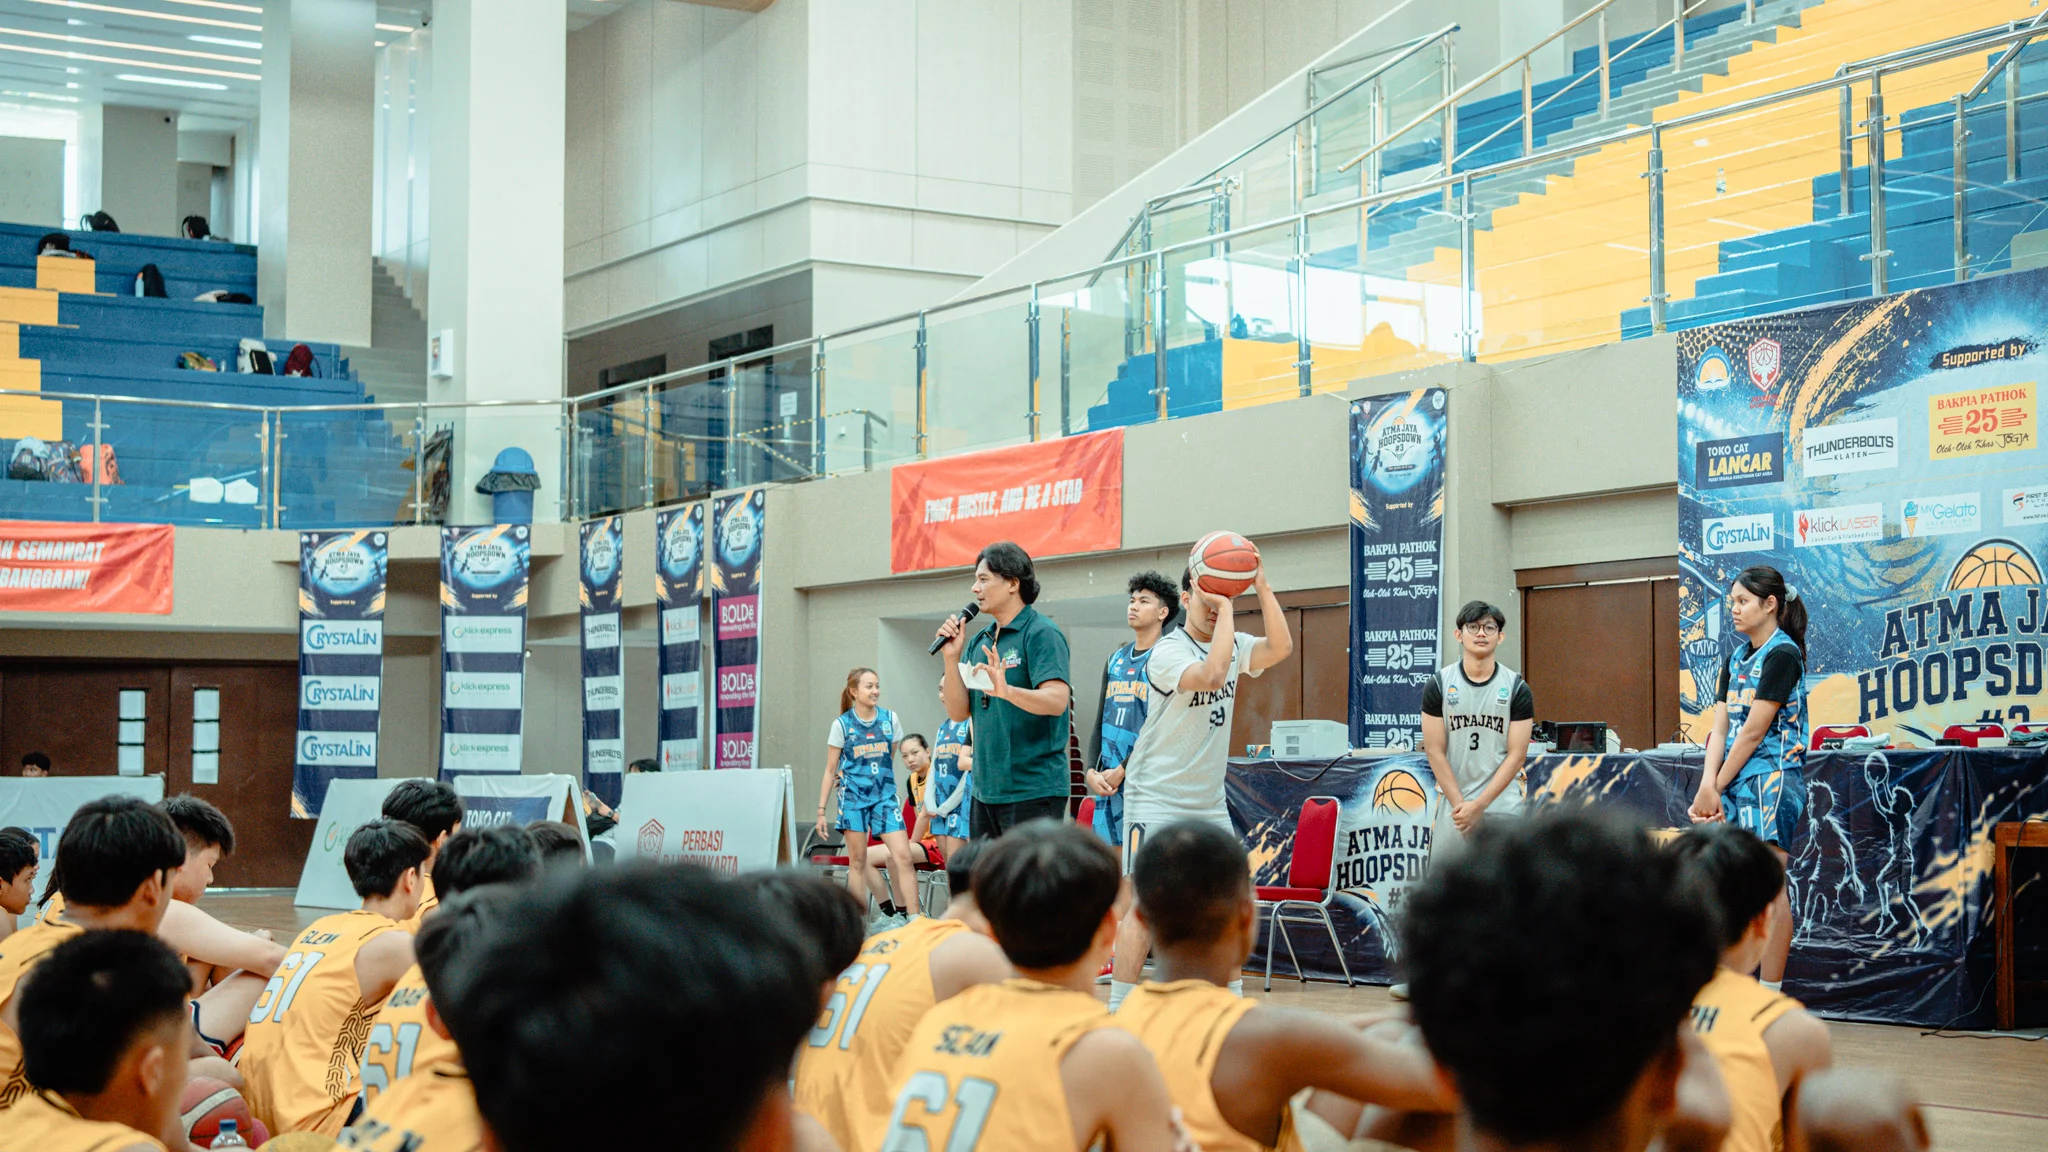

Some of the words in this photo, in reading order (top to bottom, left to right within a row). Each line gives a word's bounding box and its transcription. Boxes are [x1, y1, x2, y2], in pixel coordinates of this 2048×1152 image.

[1942, 344, 2005, 367] Supported
[2010, 343, 2026, 358] by
[1937, 395, 1978, 410] BAKPIA
[1980, 388, 2027, 404] PATHOK
[1382, 425, 1400, 437] ATMA
[1402, 424, 1417, 433] JAYA
[1965, 407, 1998, 435] 25
[1378, 433, 1421, 449] HOOPSDOWN
[1395, 443, 1404, 452] #3
[1707, 446, 1731, 457] TOKO
[1733, 443, 1749, 453] CAT
[1806, 435, 1894, 459] THUNDERBOLTS
[1975, 438, 1994, 449] Khas
[1995, 432, 2030, 449] JOGJA
[1708, 452, 1773, 477] LANCAR
[1834, 451, 1867, 460] KLATEN
[956, 490, 999, 518] HUSTLE,
[1000, 486, 1024, 513] AND
[1024, 484, 1041, 510] BE
[1040, 482, 1052, 507] A
[17, 540, 105, 563] SEMANGAT
[466, 550, 506, 559] HOOPSDOWN
[469, 544, 487, 552] ATMA
[1364, 543, 1398, 556] BAKPIA
[1399, 540, 1437, 554] PATHOK
[325, 557, 364, 566] HOOPSDOWN
[1386, 556, 1414, 583] 25
[1393, 586, 1408, 597] Khas
[1409, 584, 1438, 599] JOGJA
[1880, 590, 2009, 660] ATMA
[2016, 588, 2048, 635] J
[1364, 630, 1398, 642] BAKPIA
[1399, 628, 1437, 641] PATHOK
[1386, 643, 1413, 671] 25
[1393, 674, 1408, 685] Khas
[1106, 681, 1148, 702] ATMAJAYA
[1115, 708, 1126, 726] 11
[1364, 713, 1398, 725] BAKPIA
[1400, 713, 1422, 725] PATH
[1386, 727, 1413, 752] 25
[1469, 732, 1480, 751] 3
[870, 762, 879, 774] 8
[938, 763, 948, 778] 13
[466, 809, 492, 828] TOKO
[493, 811, 512, 826] CAT
[893, 808, 903, 822] 8
[682, 830, 724, 851] PERBASI
[1347, 825, 1403, 857] ATMA
[1408, 825, 1431, 850] JA
[250, 951, 325, 1024] 61
[808, 962, 892, 1050] 61
[359, 1022, 422, 1105] 61
[880, 1070, 998, 1152] 61
